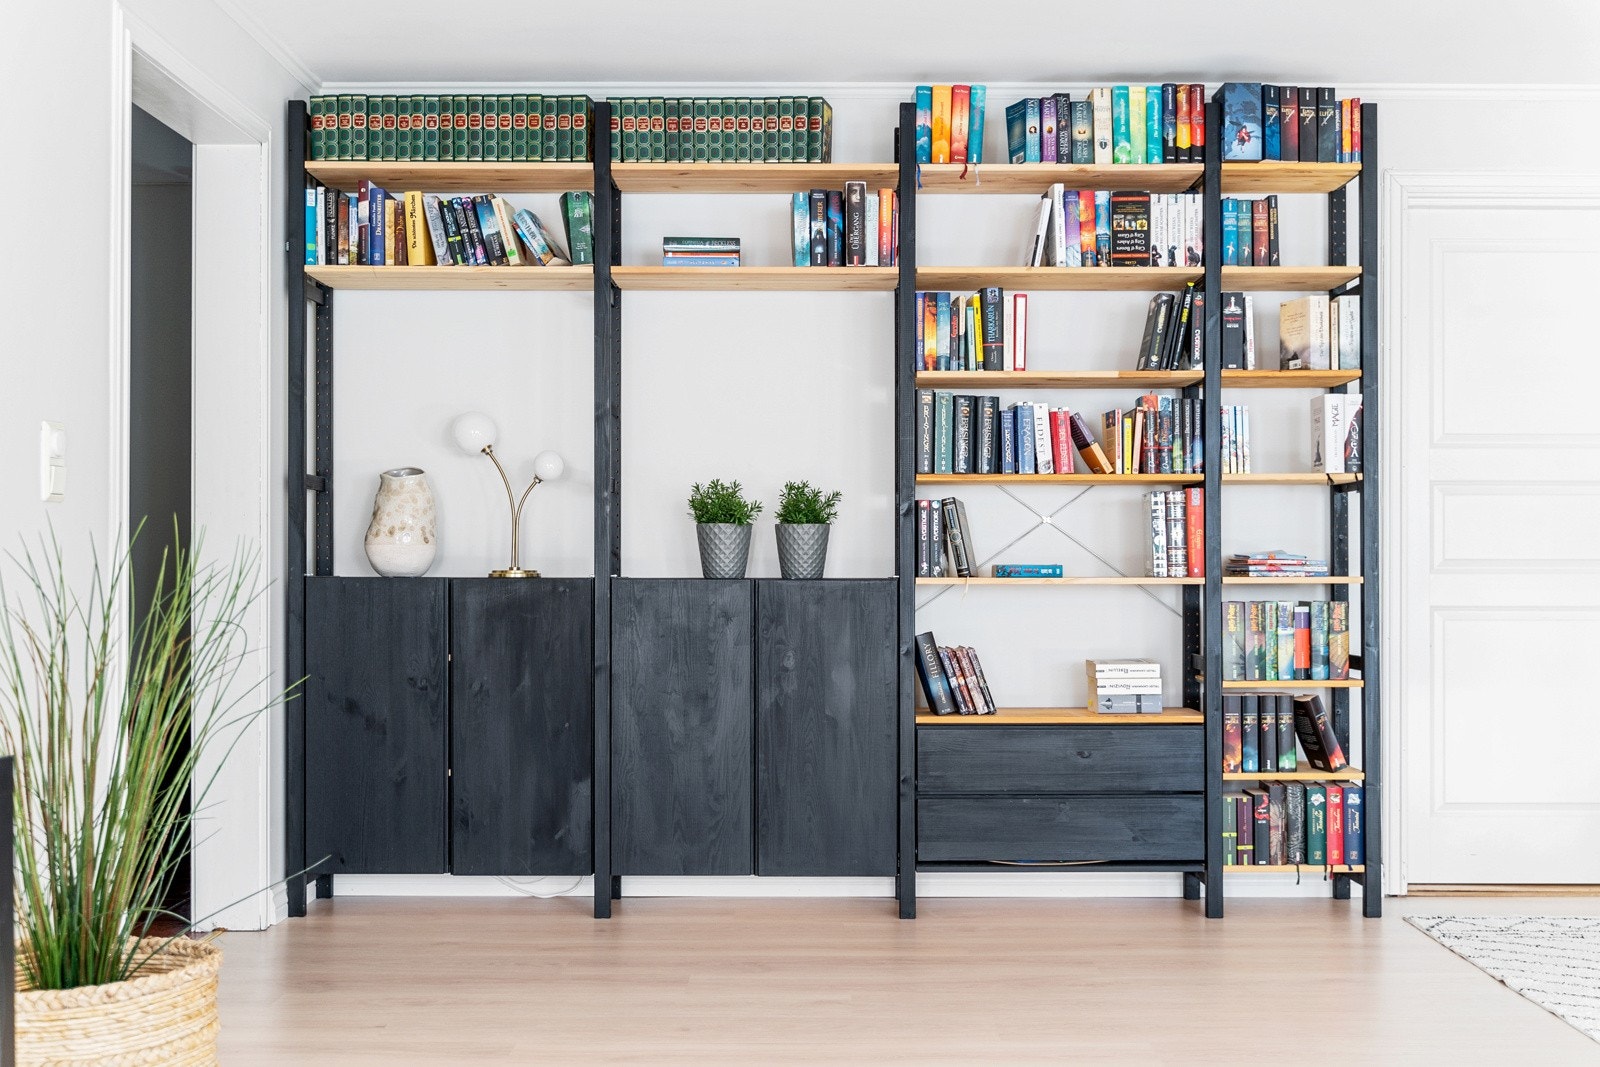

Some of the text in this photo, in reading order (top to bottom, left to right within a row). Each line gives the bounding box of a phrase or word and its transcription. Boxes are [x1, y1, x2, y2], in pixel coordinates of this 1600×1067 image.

[851, 212, 860, 250] ÜBERGANG
[1022, 419, 1031, 456] ERAGON
[1036, 417, 1046, 454] ELDEST
[924, 643, 939, 678] FILLORY
